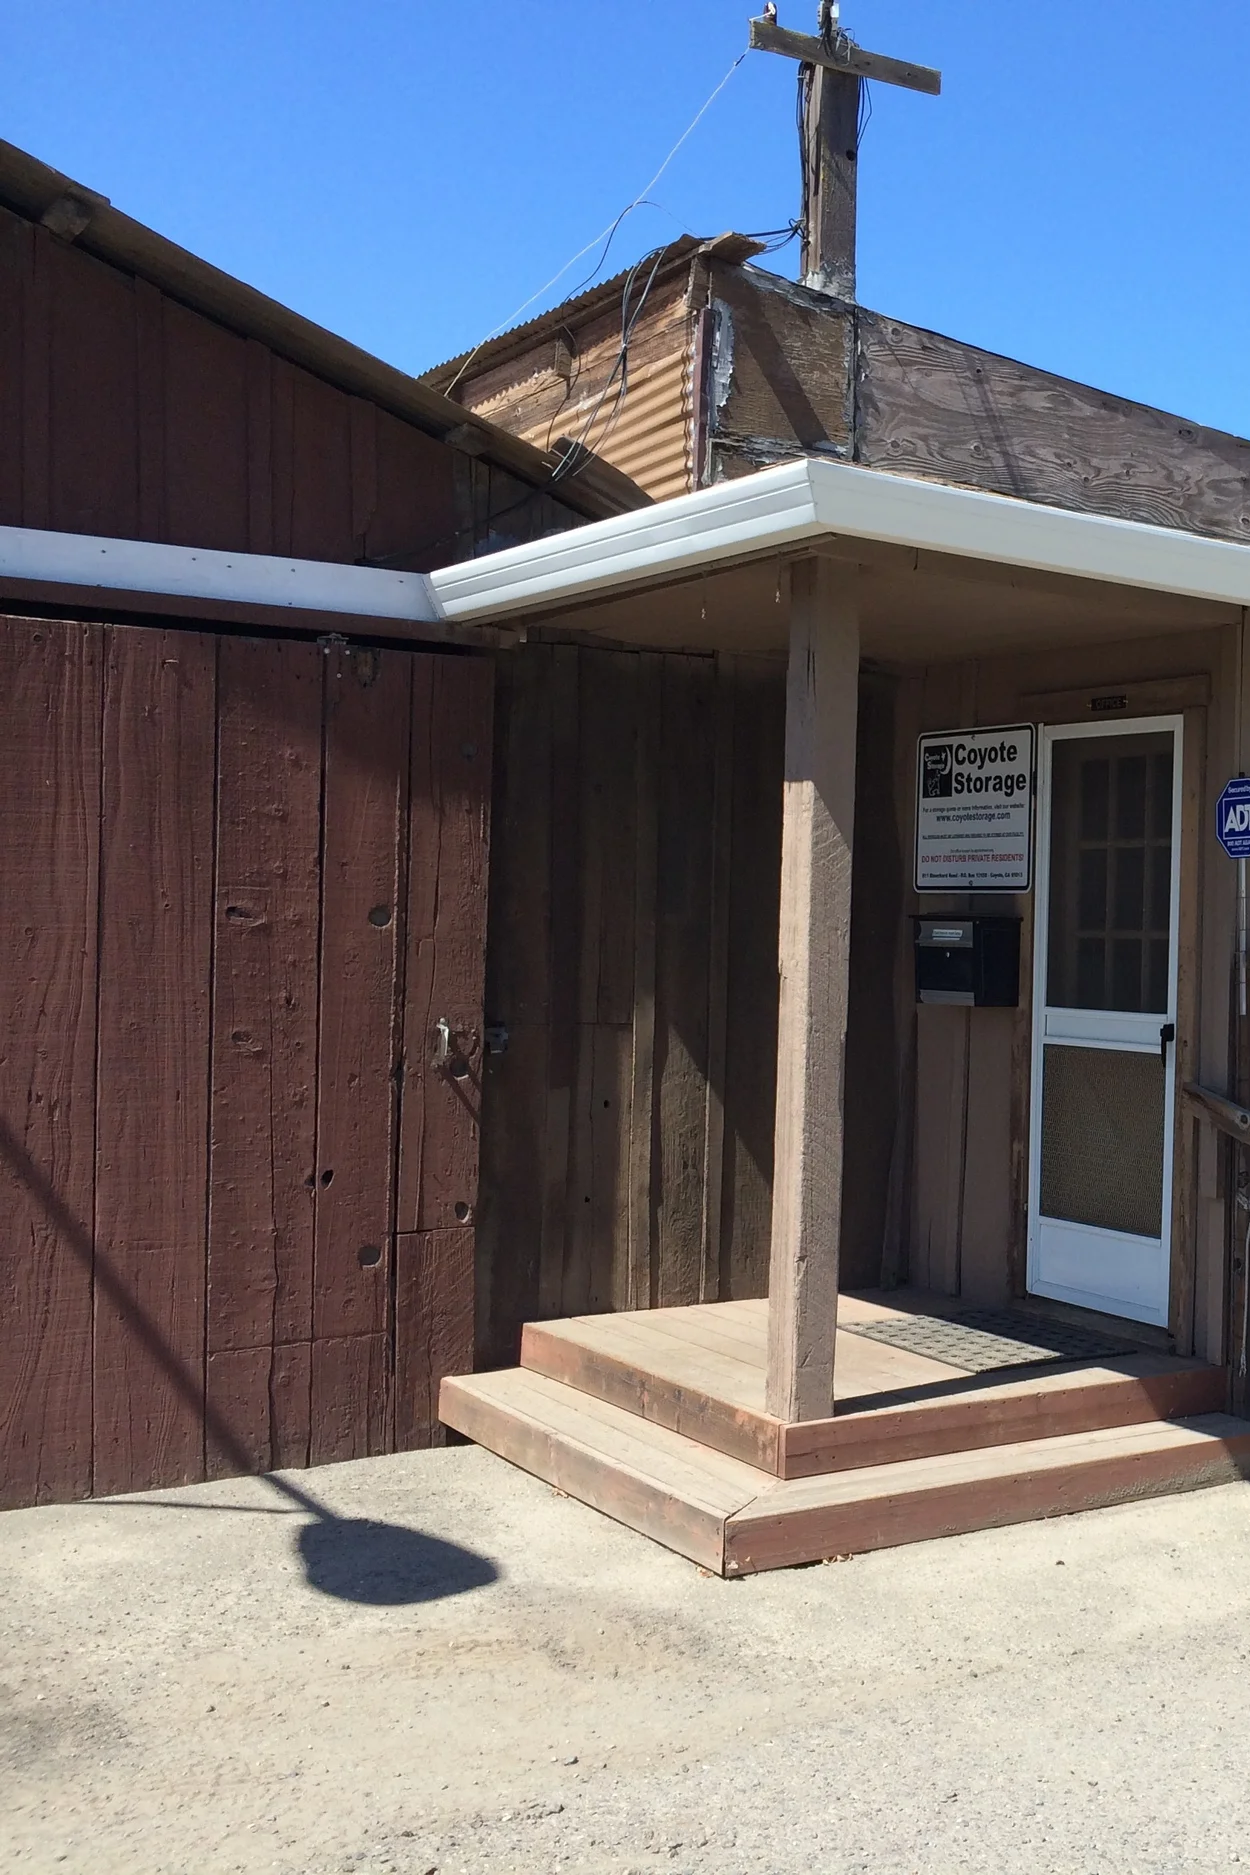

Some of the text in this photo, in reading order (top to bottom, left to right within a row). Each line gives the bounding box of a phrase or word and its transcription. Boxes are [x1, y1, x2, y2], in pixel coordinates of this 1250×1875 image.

[954, 741, 1018, 770] Coyote
[953, 772, 1027, 797] Storage
[936, 812, 1011, 824] www.coyotestorage.com
[922, 855, 930, 863] DO
[930, 855, 942, 863] NOT
[942, 854, 967, 863] DISTURB
[967, 854, 991, 862] PRIVATE
